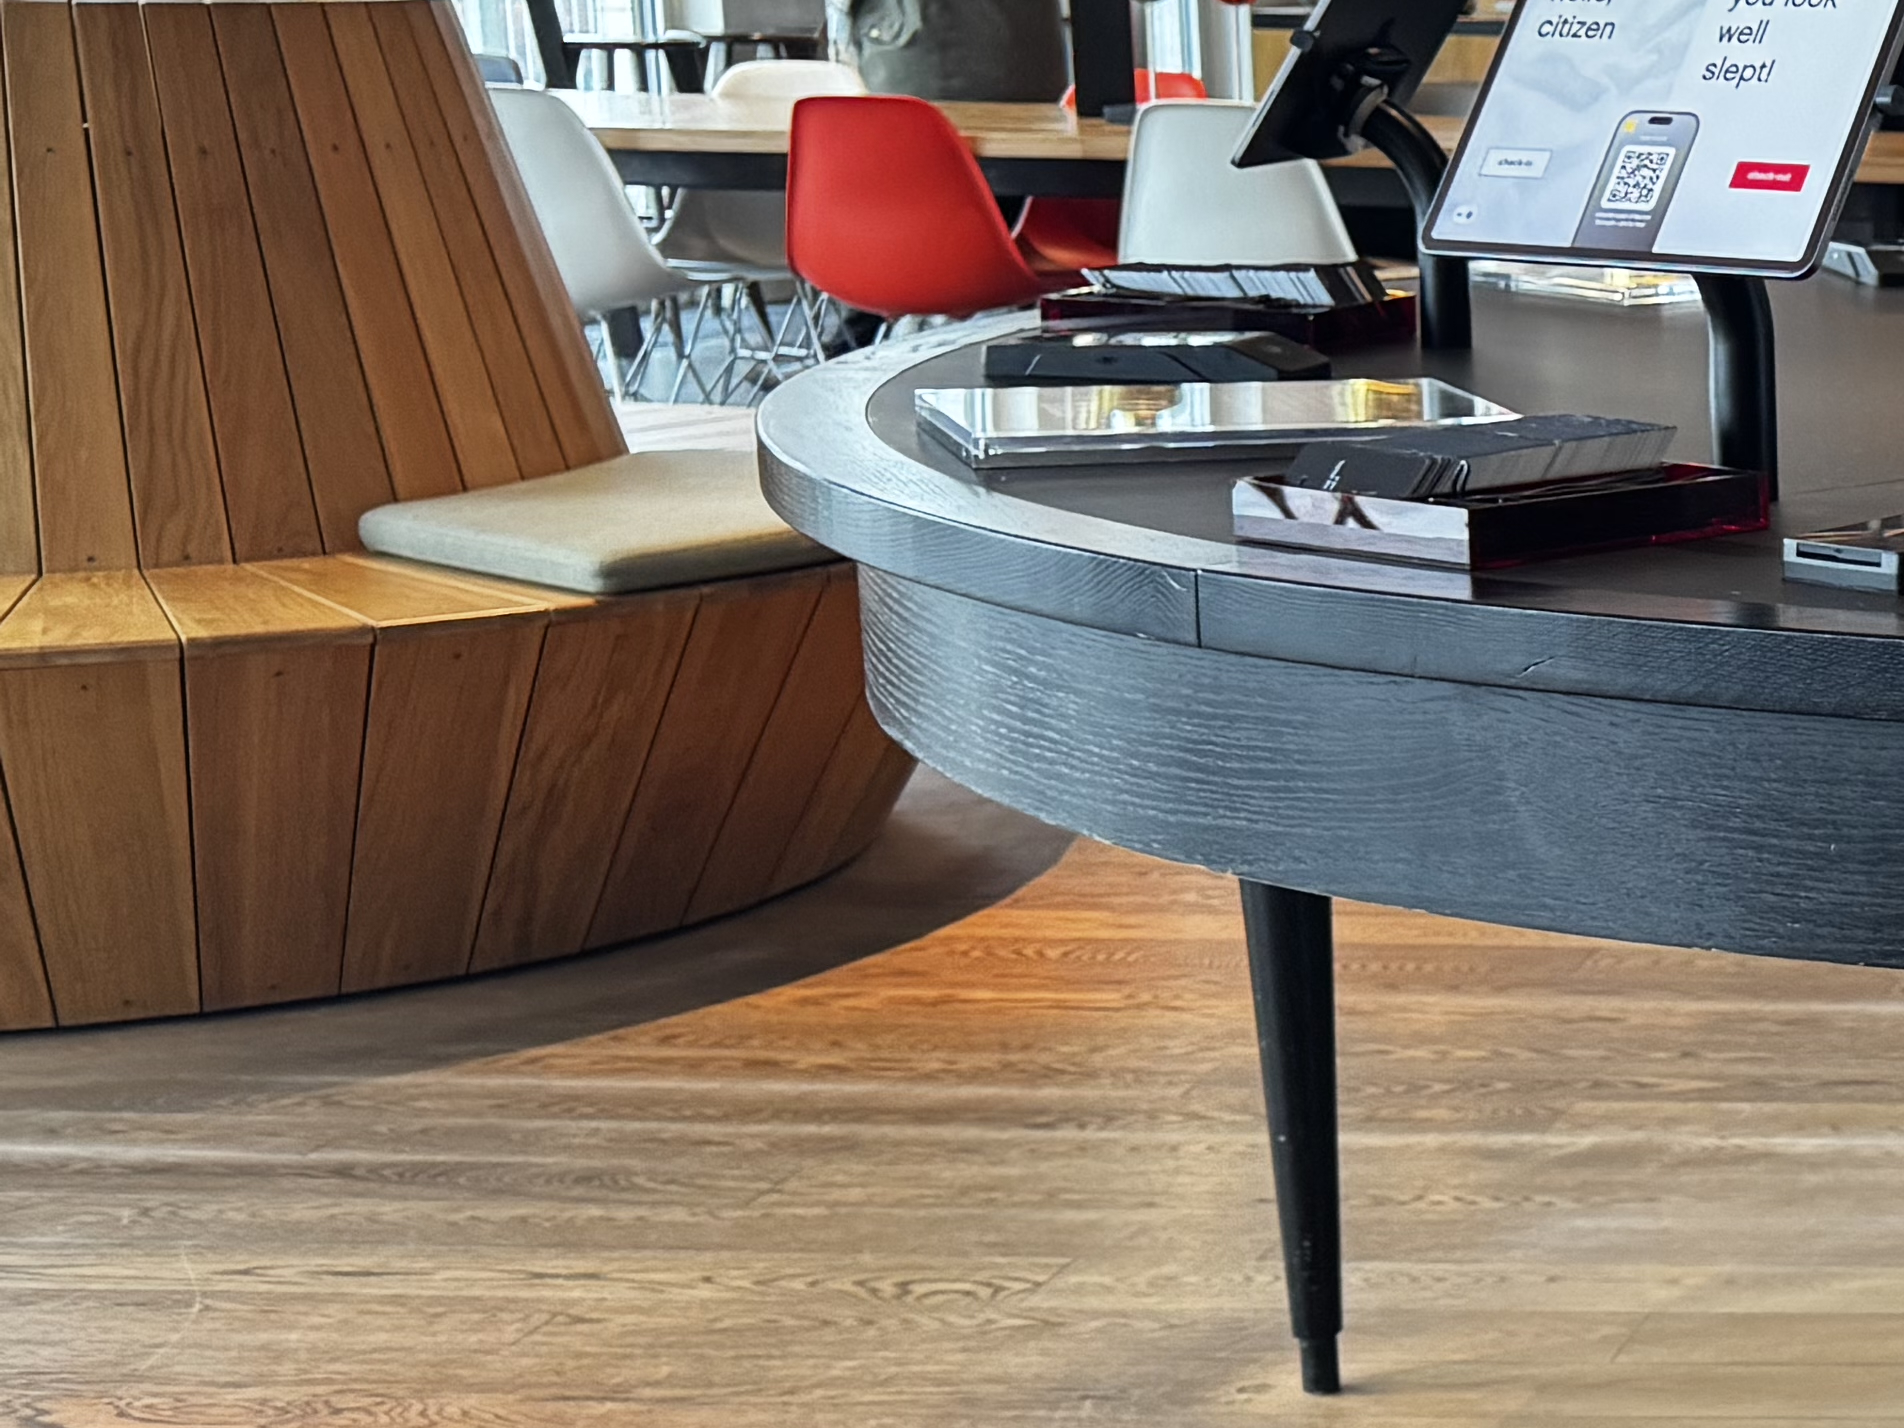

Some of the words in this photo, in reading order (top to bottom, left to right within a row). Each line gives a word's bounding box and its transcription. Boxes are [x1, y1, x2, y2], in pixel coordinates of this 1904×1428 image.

[1536, 14, 1616, 40] citizen
[1717, 19, 1770, 45] well
[1701, 55, 1776, 90] slept!
